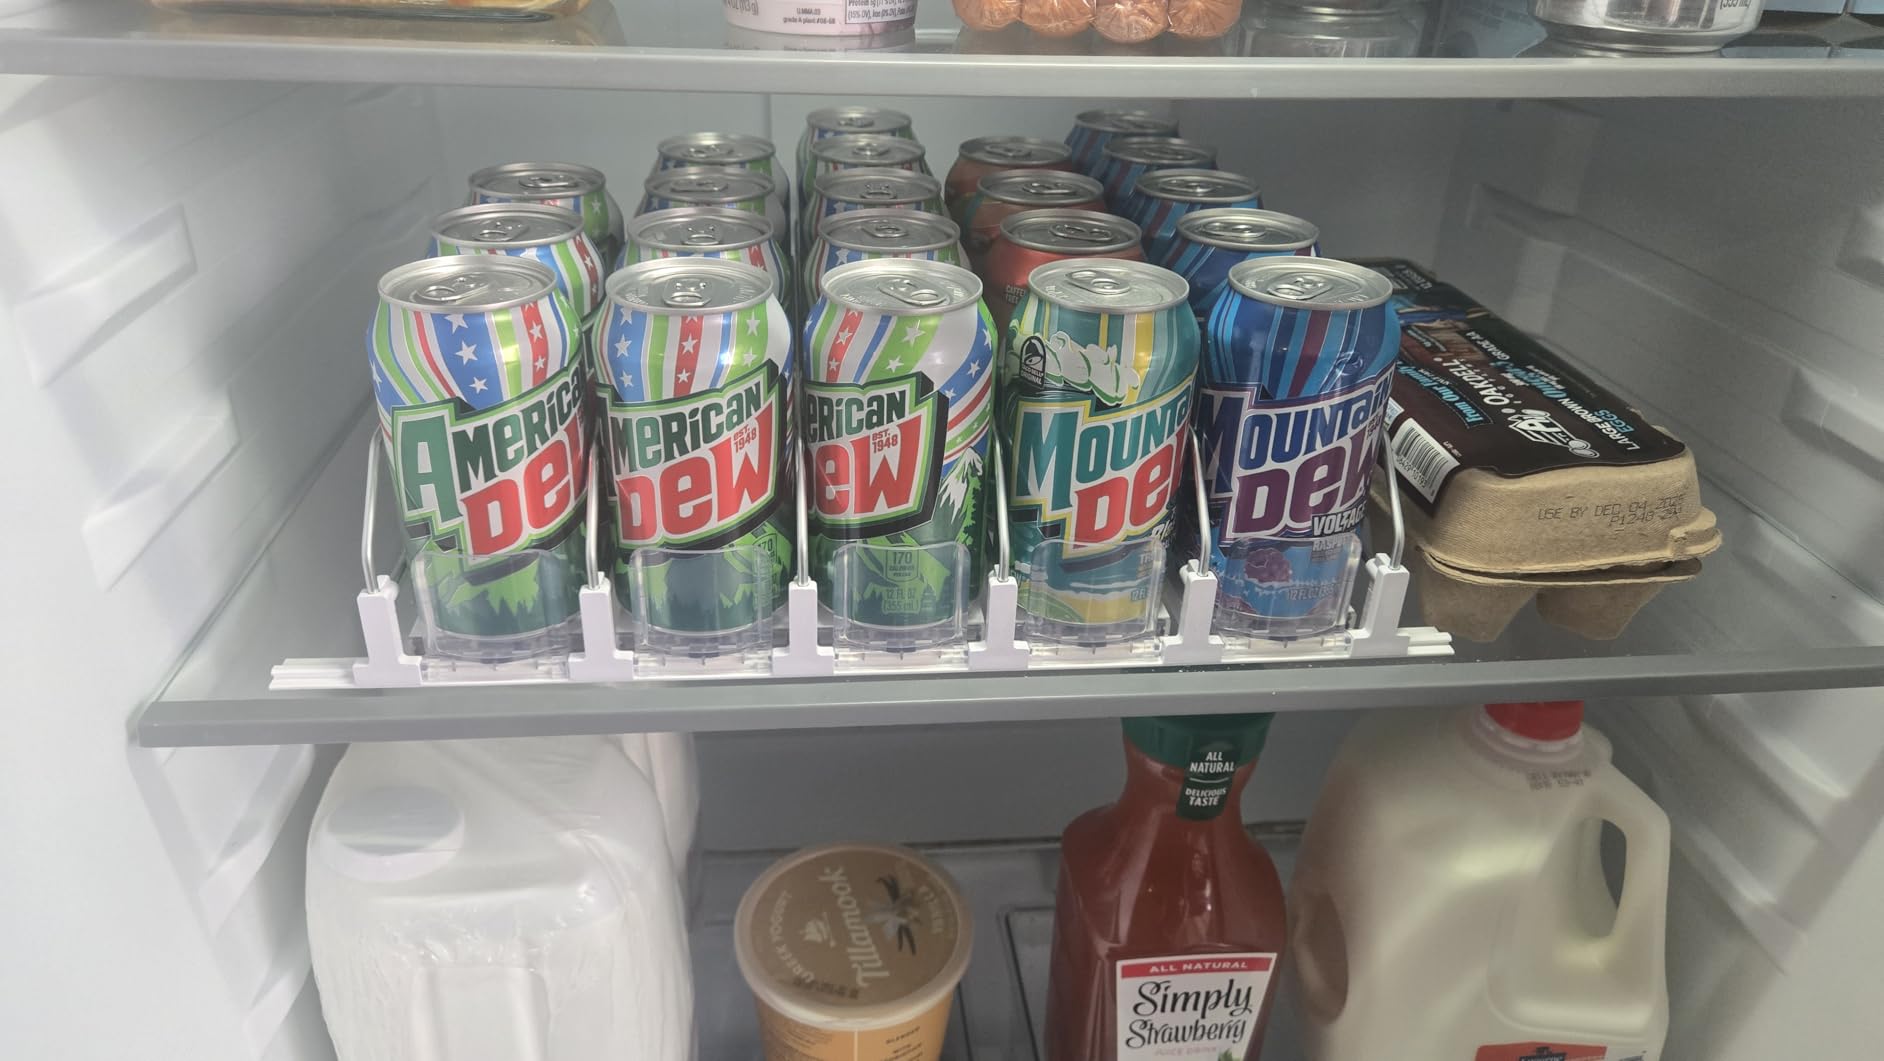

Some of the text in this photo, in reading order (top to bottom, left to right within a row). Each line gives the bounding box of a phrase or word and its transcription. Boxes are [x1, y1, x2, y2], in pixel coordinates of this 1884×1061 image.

[1442, 358, 1511, 405] OAKDELL
[1432, 385, 1460, 402] Our
[1454, 401, 1484, 423] From
[1558, 397, 1602, 426] BROWN
[1593, 409, 1635, 434] EGGS
[733, 427, 757, 453] 1948
[872, 432, 899, 454] 1948
[1598, 418, 1641, 451] LARGE
[1537, 507, 1563, 521] USE
[1569, 506, 1589, 519] BY
[1594, 503, 1622, 517] DEC
[1628, 501, 1648, 513] 04
[893, 551, 913, 565] 170
[1189, 761, 1236, 775] NATURAL
[1206, 752, 1223, 762] ALL
[1185, 786, 1228, 799] DELICIOUS
[1189, 797, 1220, 807] TASTE
[818, 865, 891, 988] Tillamook
[1149, 959, 1249, 974] ALL NATURAL
[1132, 978, 1253, 1018] Simply
[1125, 1018, 1249, 1050] Strawberry
